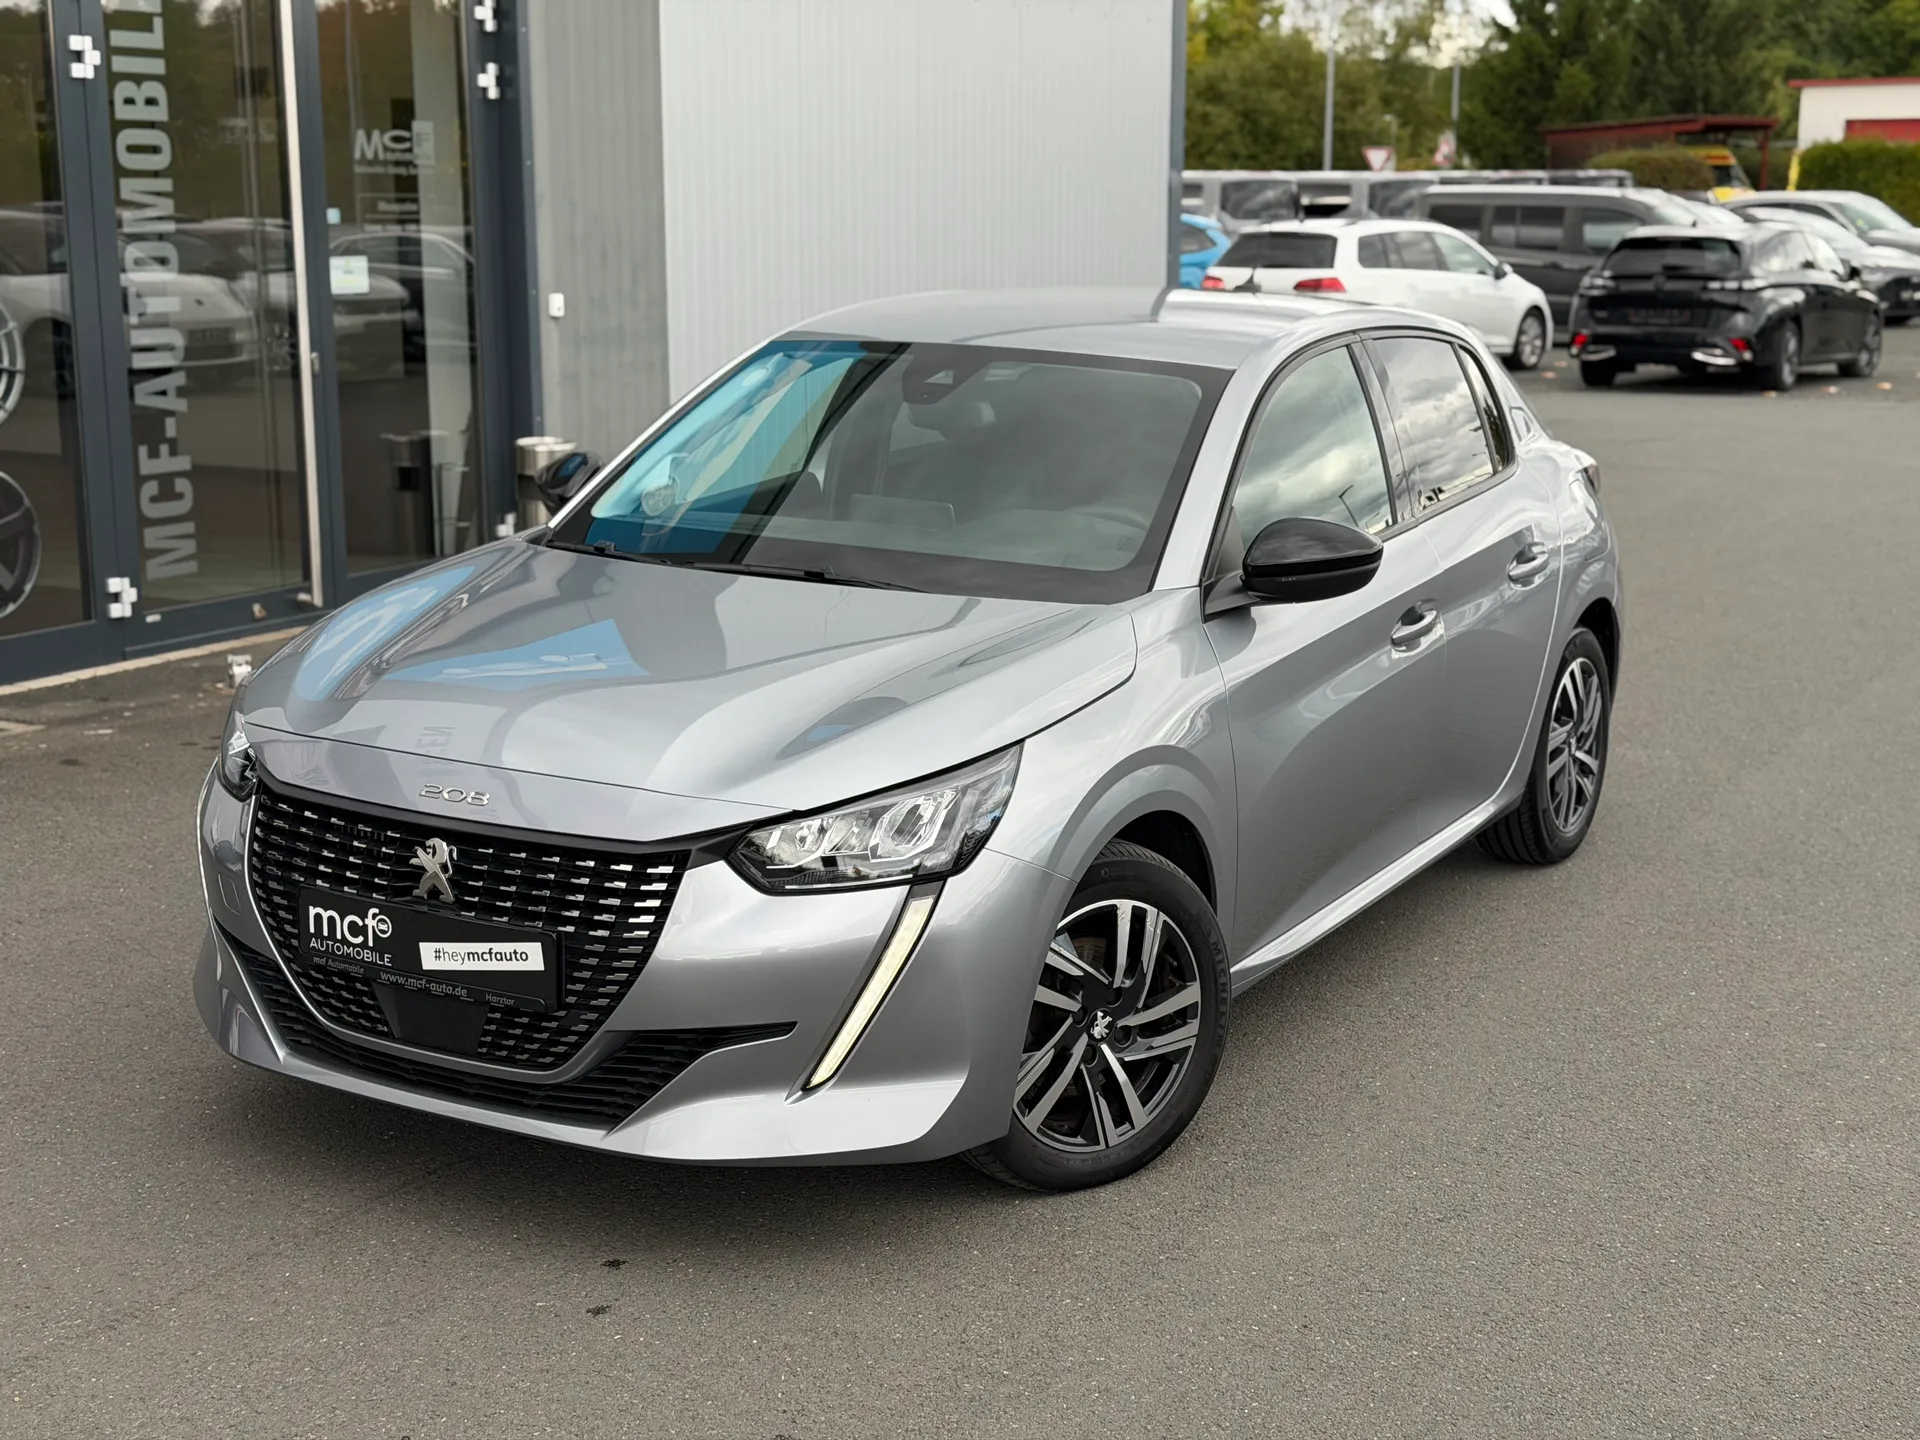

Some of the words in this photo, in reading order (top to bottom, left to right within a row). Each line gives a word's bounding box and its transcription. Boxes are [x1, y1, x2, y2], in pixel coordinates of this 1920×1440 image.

[419, 783, 491, 807] 208
[309, 937, 392, 967] AUTOMOBILE
[434, 948, 529, 966] #heymcfauto
[313, 956, 326, 966] mcf
[327, 959, 365, 974] Automobile
[380, 972, 468, 997] www.mcf-auto.de
